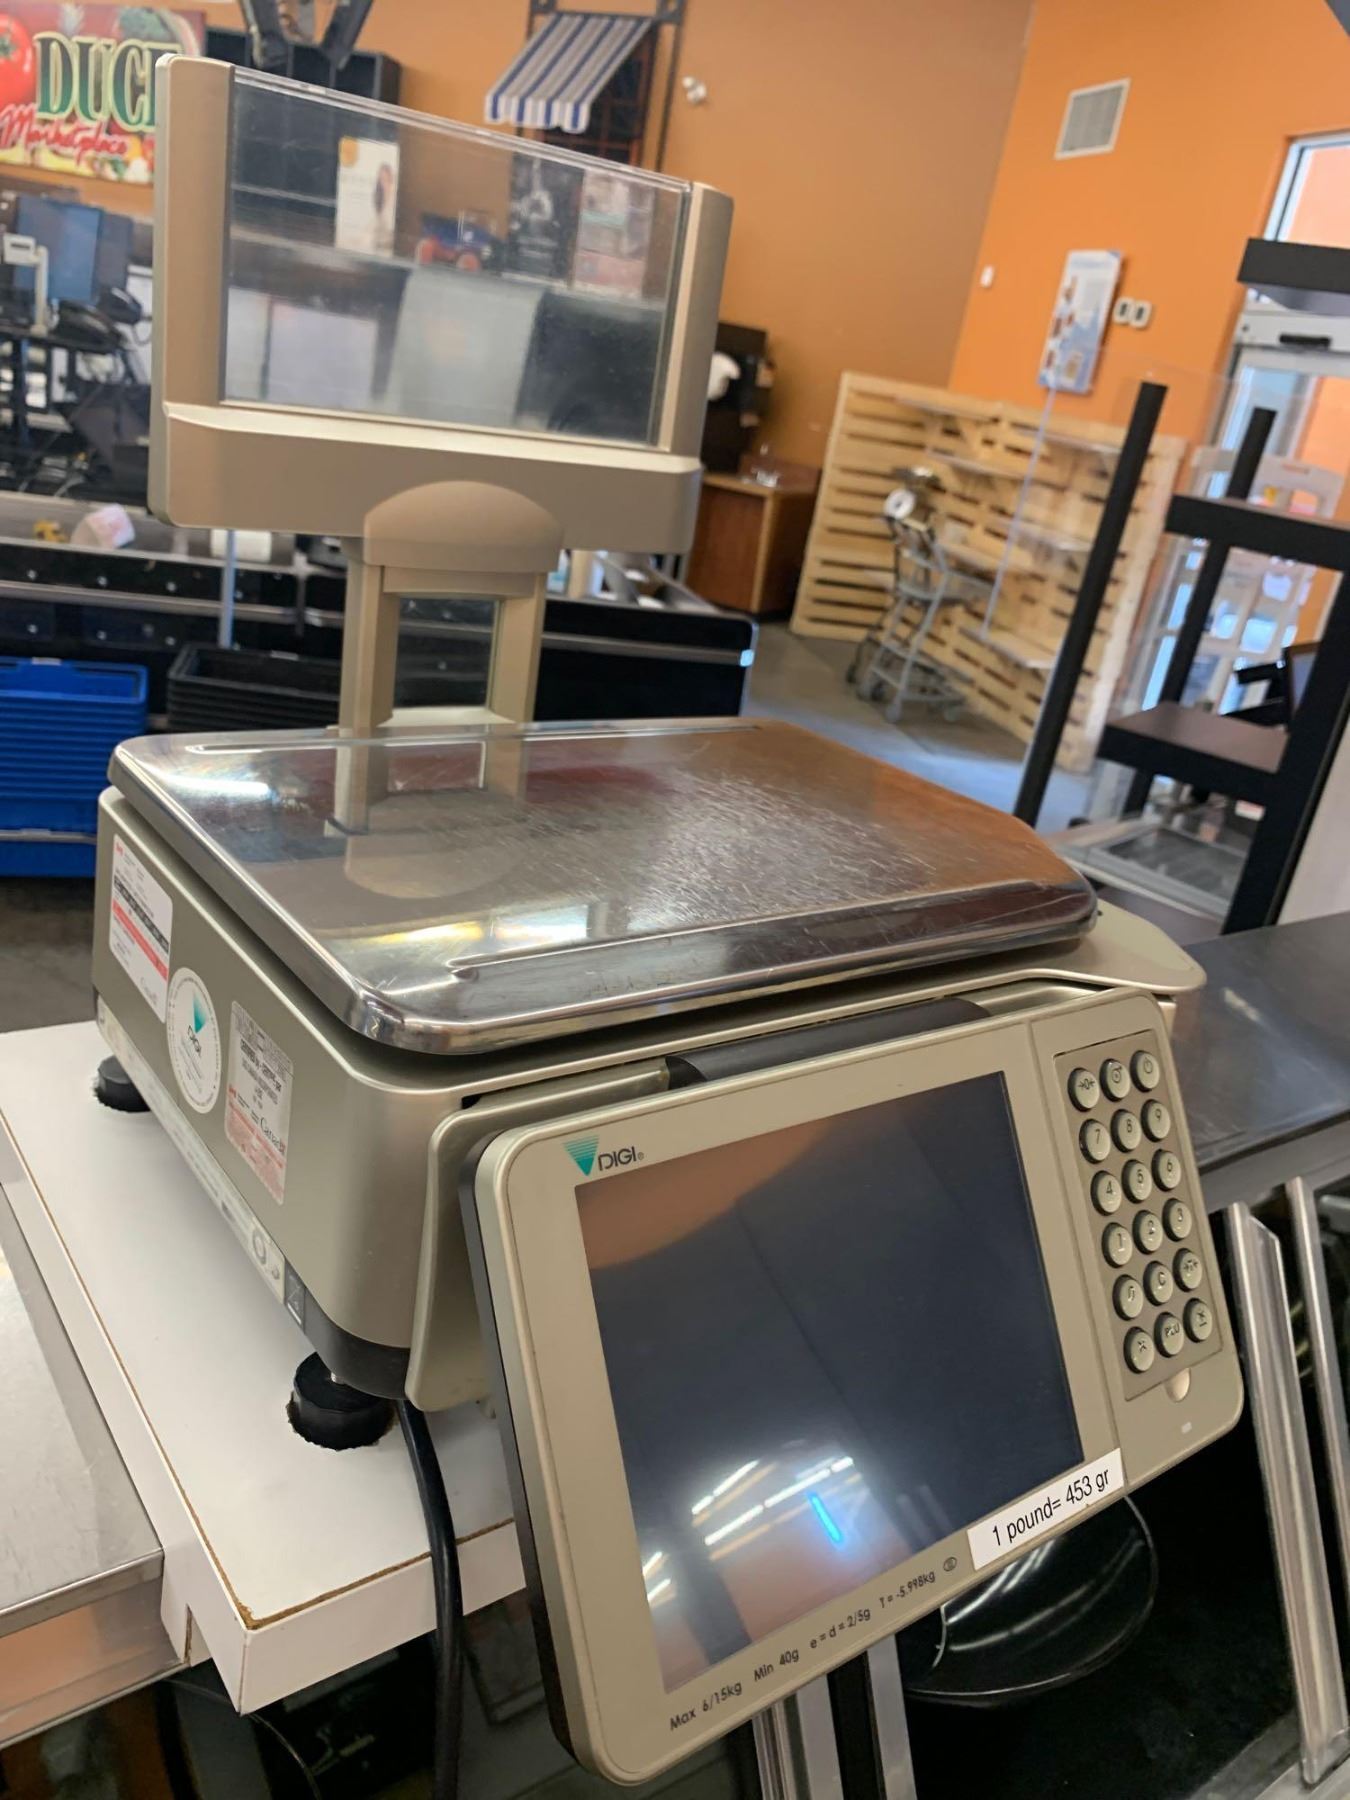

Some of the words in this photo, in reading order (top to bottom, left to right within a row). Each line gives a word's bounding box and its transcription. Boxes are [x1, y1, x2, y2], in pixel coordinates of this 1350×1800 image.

[1095, 1128, 1101, 1145] 7
[1155, 1108, 1163, 1122] 9
[598, 1145, 637, 1172] DIGI
[1106, 1180, 1114, 1195] 4
[1166, 1158, 1173, 1172] 6
[1147, 1219, 1156, 1235] 2
[992, 1525, 1001, 1547] 1
[1006, 1496, 1062, 1544] pound=
[1065, 1475, 1093, 1505] 453
[1095, 1468, 1109, 1493] gr
[669, 1708, 697, 1731] Max
[702, 1682, 742, 1712] 6/15kg
[753, 1664, 775, 1682] Min
[779, 1649, 799, 1666] 40g
